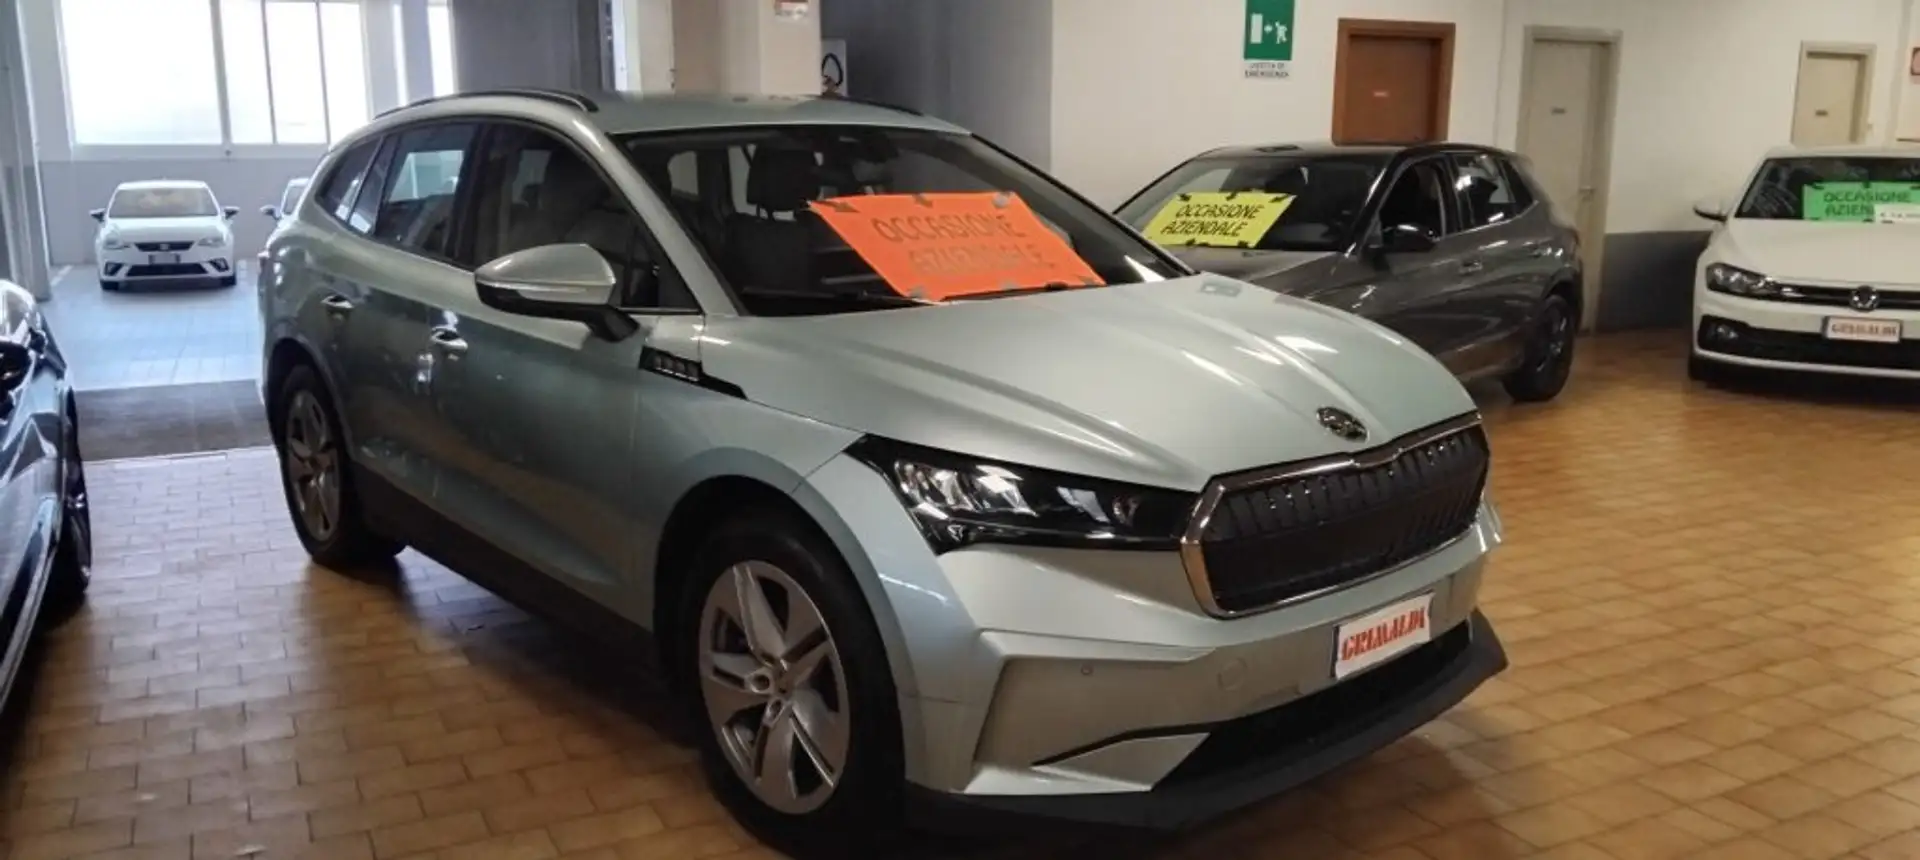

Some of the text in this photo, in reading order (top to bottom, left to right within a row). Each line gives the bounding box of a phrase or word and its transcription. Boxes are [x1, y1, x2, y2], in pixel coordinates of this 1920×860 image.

[1823, 189, 1911, 203] OCCASIONE
[1176, 203, 1265, 219] OCCASIONE
[1824, 203, 1874, 217] AZIEN
[872, 210, 1027, 243] OCCASIONE
[1160, 219, 1249, 237] AZIENDALE
[908, 242, 1054, 276] AZIENDALE
